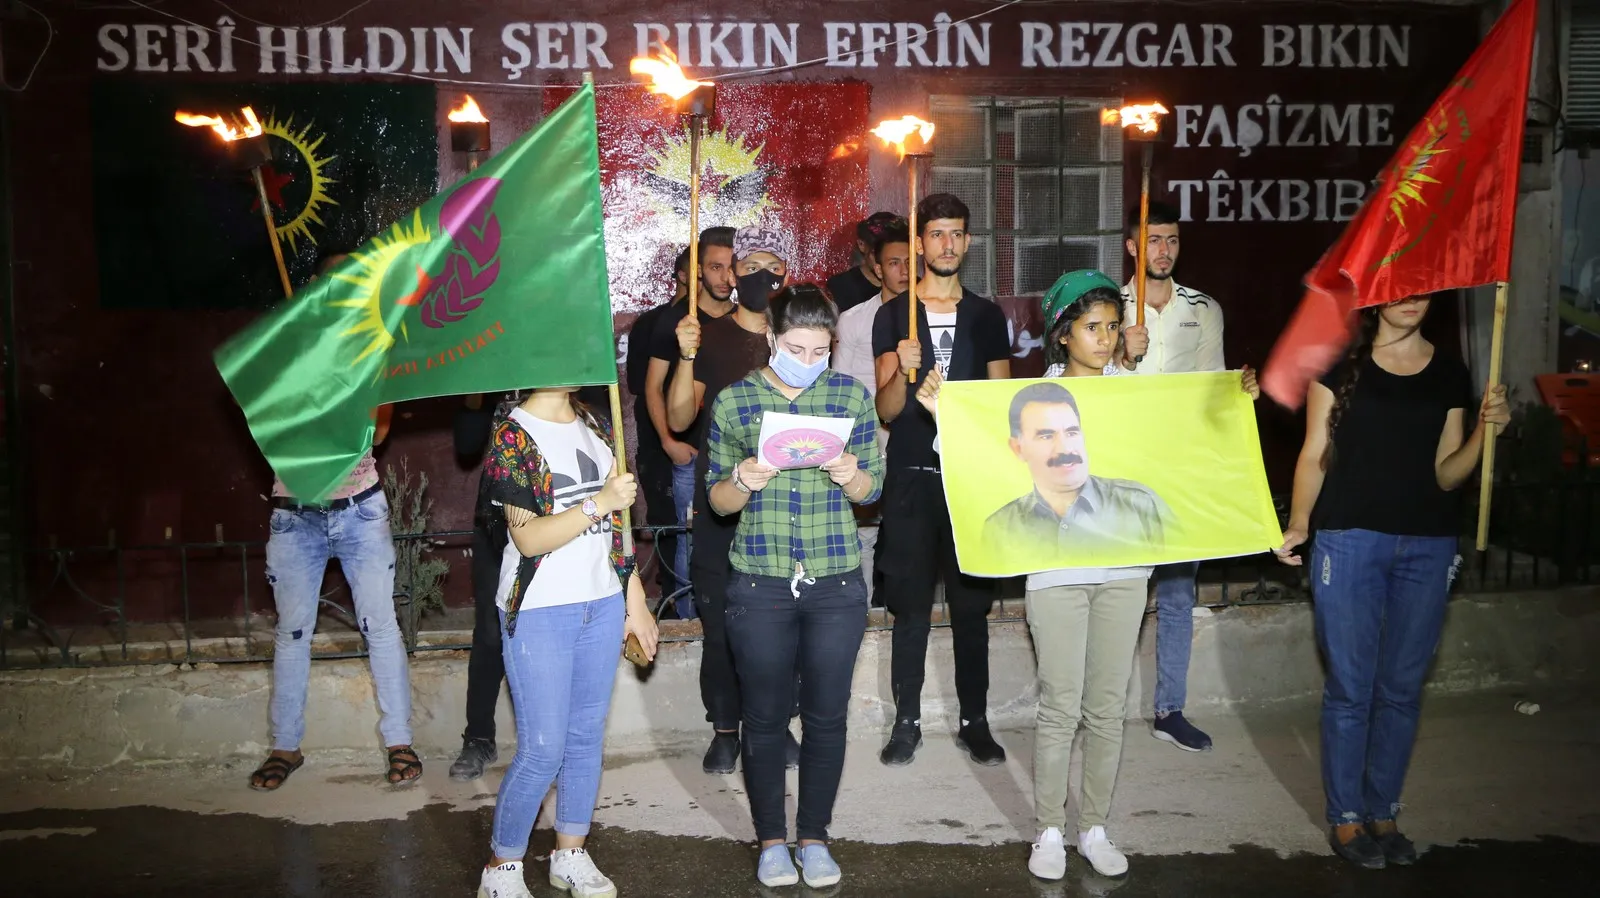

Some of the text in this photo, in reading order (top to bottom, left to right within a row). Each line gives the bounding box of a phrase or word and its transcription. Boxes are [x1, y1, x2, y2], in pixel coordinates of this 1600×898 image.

[97, 15, 237, 73] SERÎ
[256, 26, 474, 74] HILDIN
[501, 21, 613, 80] ŞER
[823, 12, 992, 67] EFRÎN
[1019, 22, 1237, 68] REZGAR
[1261, 24, 1411, 68] BIKIN
[1173, 94, 1395, 157] FAŞÎZME
[1168, 169, 1379, 222] TÊKBIB
